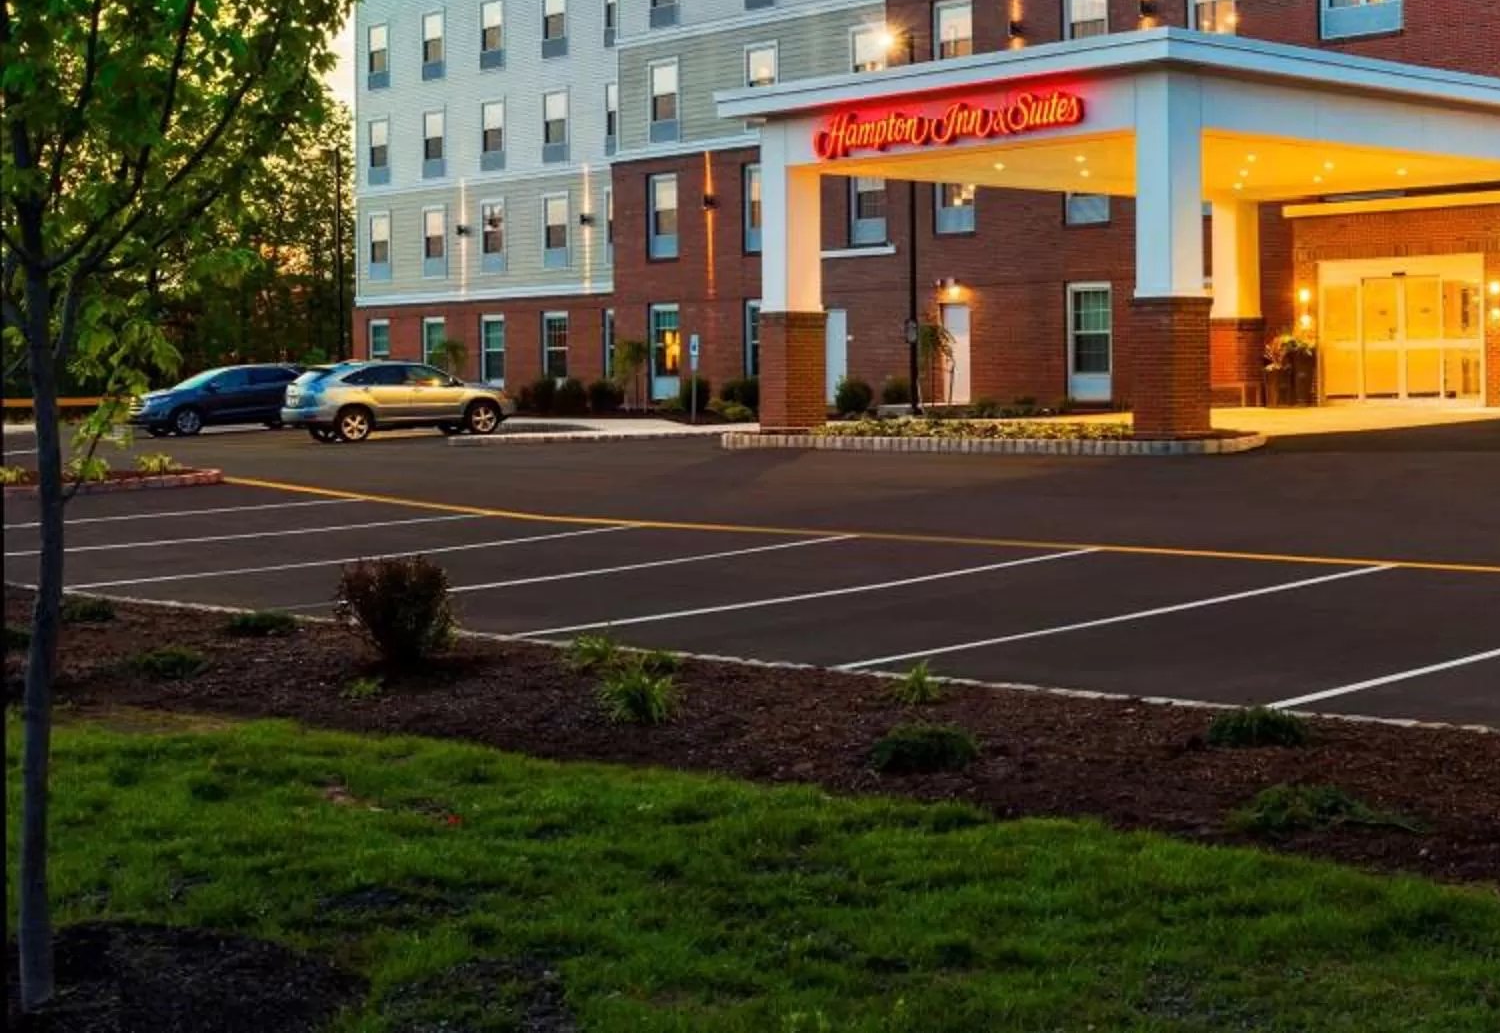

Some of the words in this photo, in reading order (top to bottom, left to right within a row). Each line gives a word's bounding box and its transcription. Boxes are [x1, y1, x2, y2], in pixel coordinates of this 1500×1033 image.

[814, 112, 929, 160] Hampton
[930, 103, 994, 144] Inn
[1006, 91, 1082, 131] Suites
